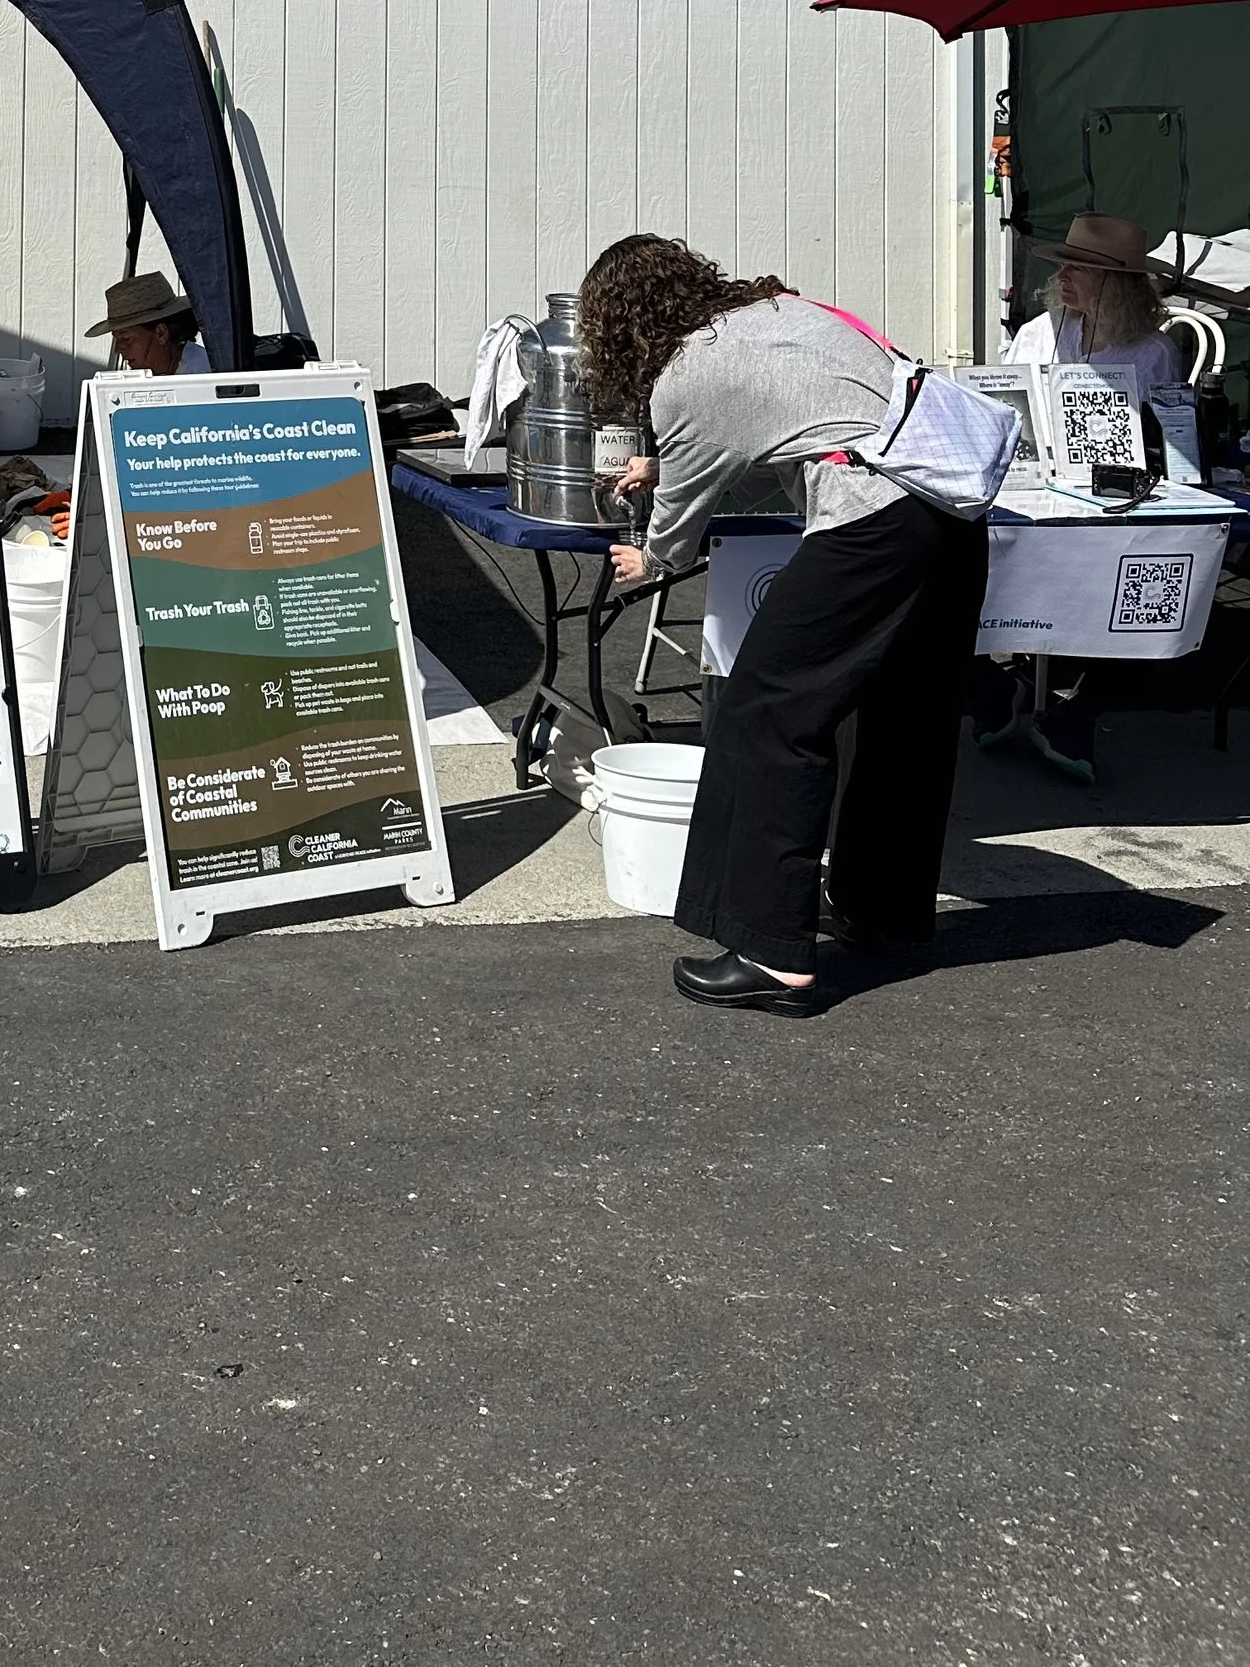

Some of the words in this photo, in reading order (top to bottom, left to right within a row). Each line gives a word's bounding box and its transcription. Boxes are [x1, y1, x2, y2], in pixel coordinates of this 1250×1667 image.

[124, 431, 167, 449] Keep
[169, 424, 261, 444] California's
[263, 421, 309, 439] Coast
[311, 420, 356, 436] Clean
[601, 436, 635, 444] WATER
[127, 459, 154, 470] Your
[156, 456, 182, 470] help
[184, 454, 232, 470] protects
[235, 452, 253, 464] the
[255, 450, 285, 463] coast
[287, 448, 304, 461] for
[306, 448, 361, 461] everyone.
[136, 524, 173, 537] Know
[174, 519, 217, 534] Before
[138, 538, 161, 552] You
[163, 536, 182, 550] Go
[146, 605, 183, 621] Trash
[183, 604, 213, 617] Your
[213, 598, 249, 614] Trash
[999, 619, 1053, 629] initiative
[156, 687, 193, 703] What
[194, 685, 210, 699] To
[211, 683, 230, 697] Do
[158, 702, 191, 719] With
[192, 701, 225, 715] Poop
[167, 776, 186, 790] Be
[187, 765, 266, 788] Considerate
[170, 791, 185, 806] of
[186, 784, 238, 804] Coastal
[171, 799, 258, 822] Communities
[394, 806, 412, 815] Marin
[305, 832, 340, 845] CLEANER
[401, 828, 423, 837] COUNTY
[311, 839, 358, 853] CALIFORNIA
[308, 852, 334, 863] COAST
